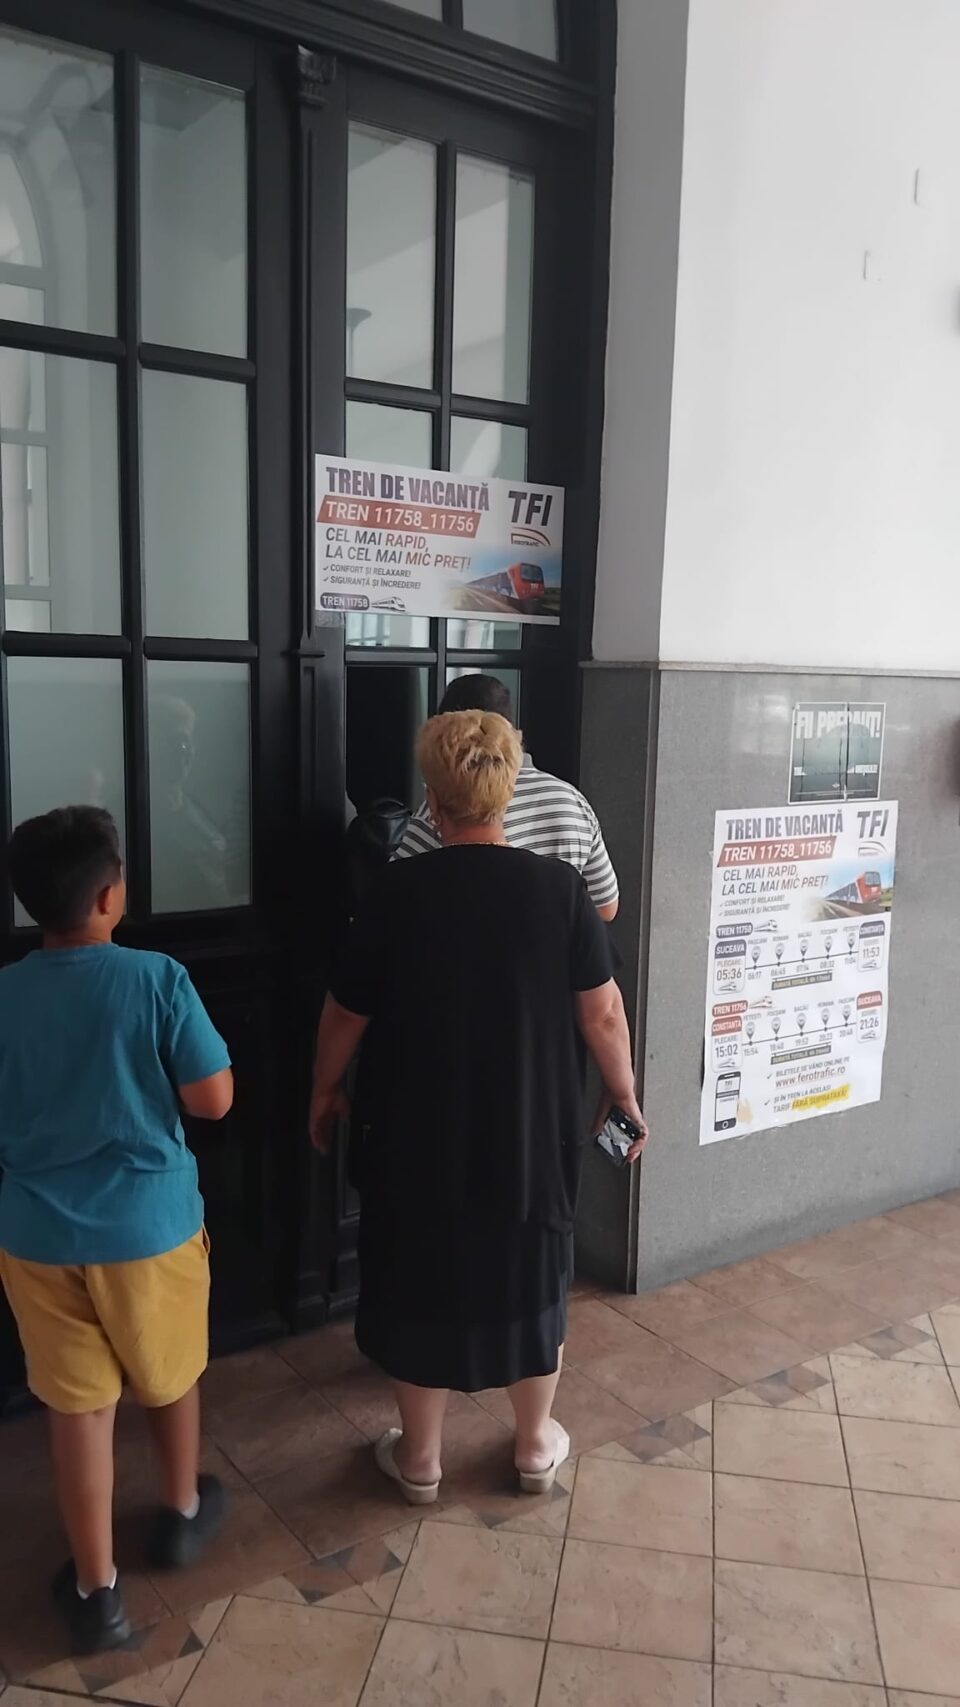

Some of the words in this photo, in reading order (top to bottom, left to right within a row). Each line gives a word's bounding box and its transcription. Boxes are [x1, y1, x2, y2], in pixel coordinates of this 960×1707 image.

[325, 466, 375, 498] TREN
[380, 473, 404, 501] DE
[408, 476, 490, 513] VACANȚĂ
[325, 500, 369, 522] TREN
[374, 506, 475, 533] 11758_11756
[508, 490, 553, 527] TFI
[325, 527, 351, 543] CEL
[354, 530, 383, 545] MAI
[385, 533, 429, 552] RAPID,
[325, 544, 343, 560] LA
[347, 546, 372, 562] CEL
[375, 548, 403, 565] MAI
[405, 551, 431, 567] MIC
[433, 554, 471, 573] PREȚ!
[330, 563, 363, 574] CONFORT
[373, 567, 411, 578] RELAXARE!
[380, 578, 421, 590] ÎNCREDERE!
[322, 595, 345, 607] TREN
[346, 596, 368, 608] 11758
[726, 816, 761, 841] TREN
[765, 815, 782, 838] DE
[784, 809, 844, 837] VACANȚĂ
[857, 809, 889, 839] TFI
[723, 846, 757, 863] TREN
[759, 840, 832, 860] 11758_11756
[723, 868, 743, 882] CEL
[745, 866, 766, 880] MAI
[767, 864, 799, 878] RAPID,
[721, 883, 736, 896] LA
[738, 881, 757, 894] CEL
[759, 879, 779, 892] MAI
[781, 877, 800, 891] MIC
[717, 928, 735, 937] TREN
[716, 944, 745, 955] SUCEAVA
[863, 946, 880, 959] 11:53
[716, 968, 742, 981] 05:36
[713, 1005, 731, 1015] TREN
[860, 1017, 879, 1030] 21:26
[715, 1043, 738, 1058] 15:02
